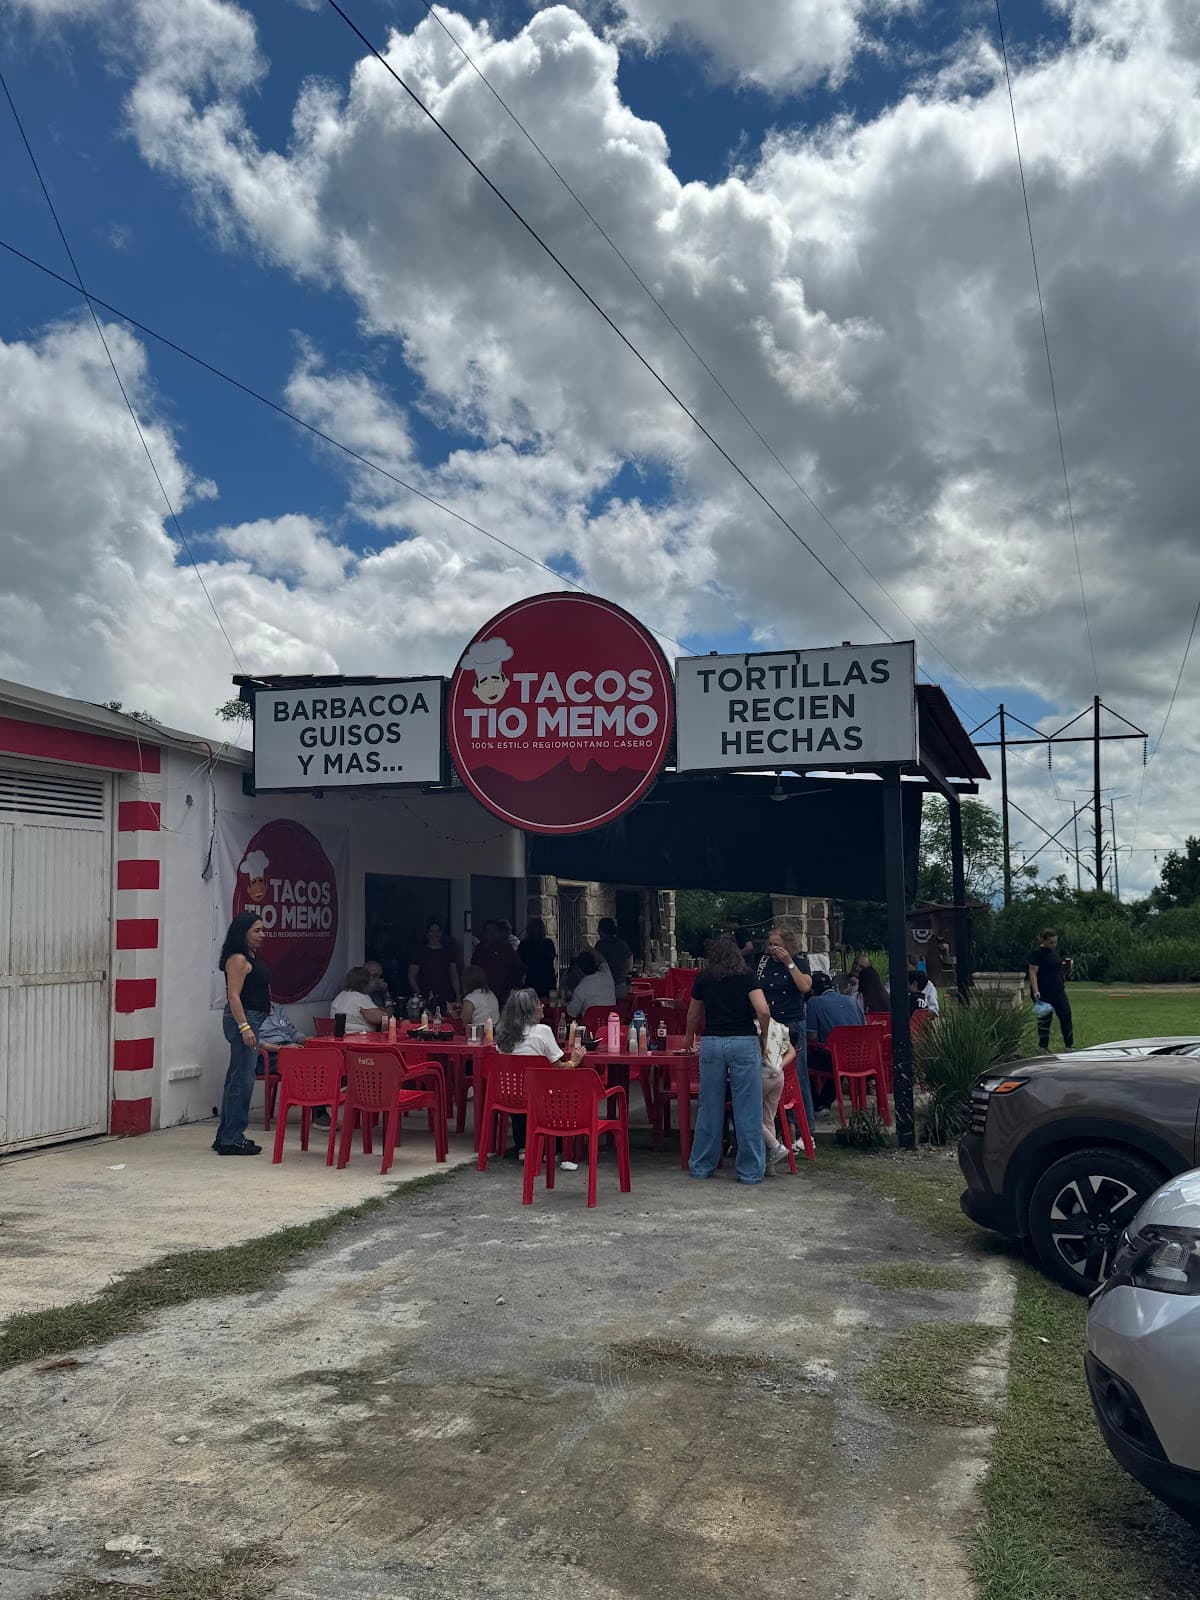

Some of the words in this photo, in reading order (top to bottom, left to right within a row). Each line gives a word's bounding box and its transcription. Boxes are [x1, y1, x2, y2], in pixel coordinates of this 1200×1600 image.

[514, 669, 654, 704] TACOS
[697, 658, 890, 693] TORTILLAS
[273, 692, 430, 722] BARBACOA
[463, 707, 528, 739] TIO
[537, 704, 659, 738] MEMO
[728, 693, 855, 723] RECIEN
[299, 722, 401, 748] GUISOS
[471, 742, 494, 750] 100%
[497, 741, 529, 749] ESTILO
[532, 740, 610, 749] REGIOMONTANO
[613, 739, 653, 748] CASERO
[721, 726, 863, 755] HECHAS
[297, 754, 315, 776] Y
[324, 751, 403, 774] MAS...
[270, 878, 331, 905] TACOS
[281, 905, 332, 930] MEMO
